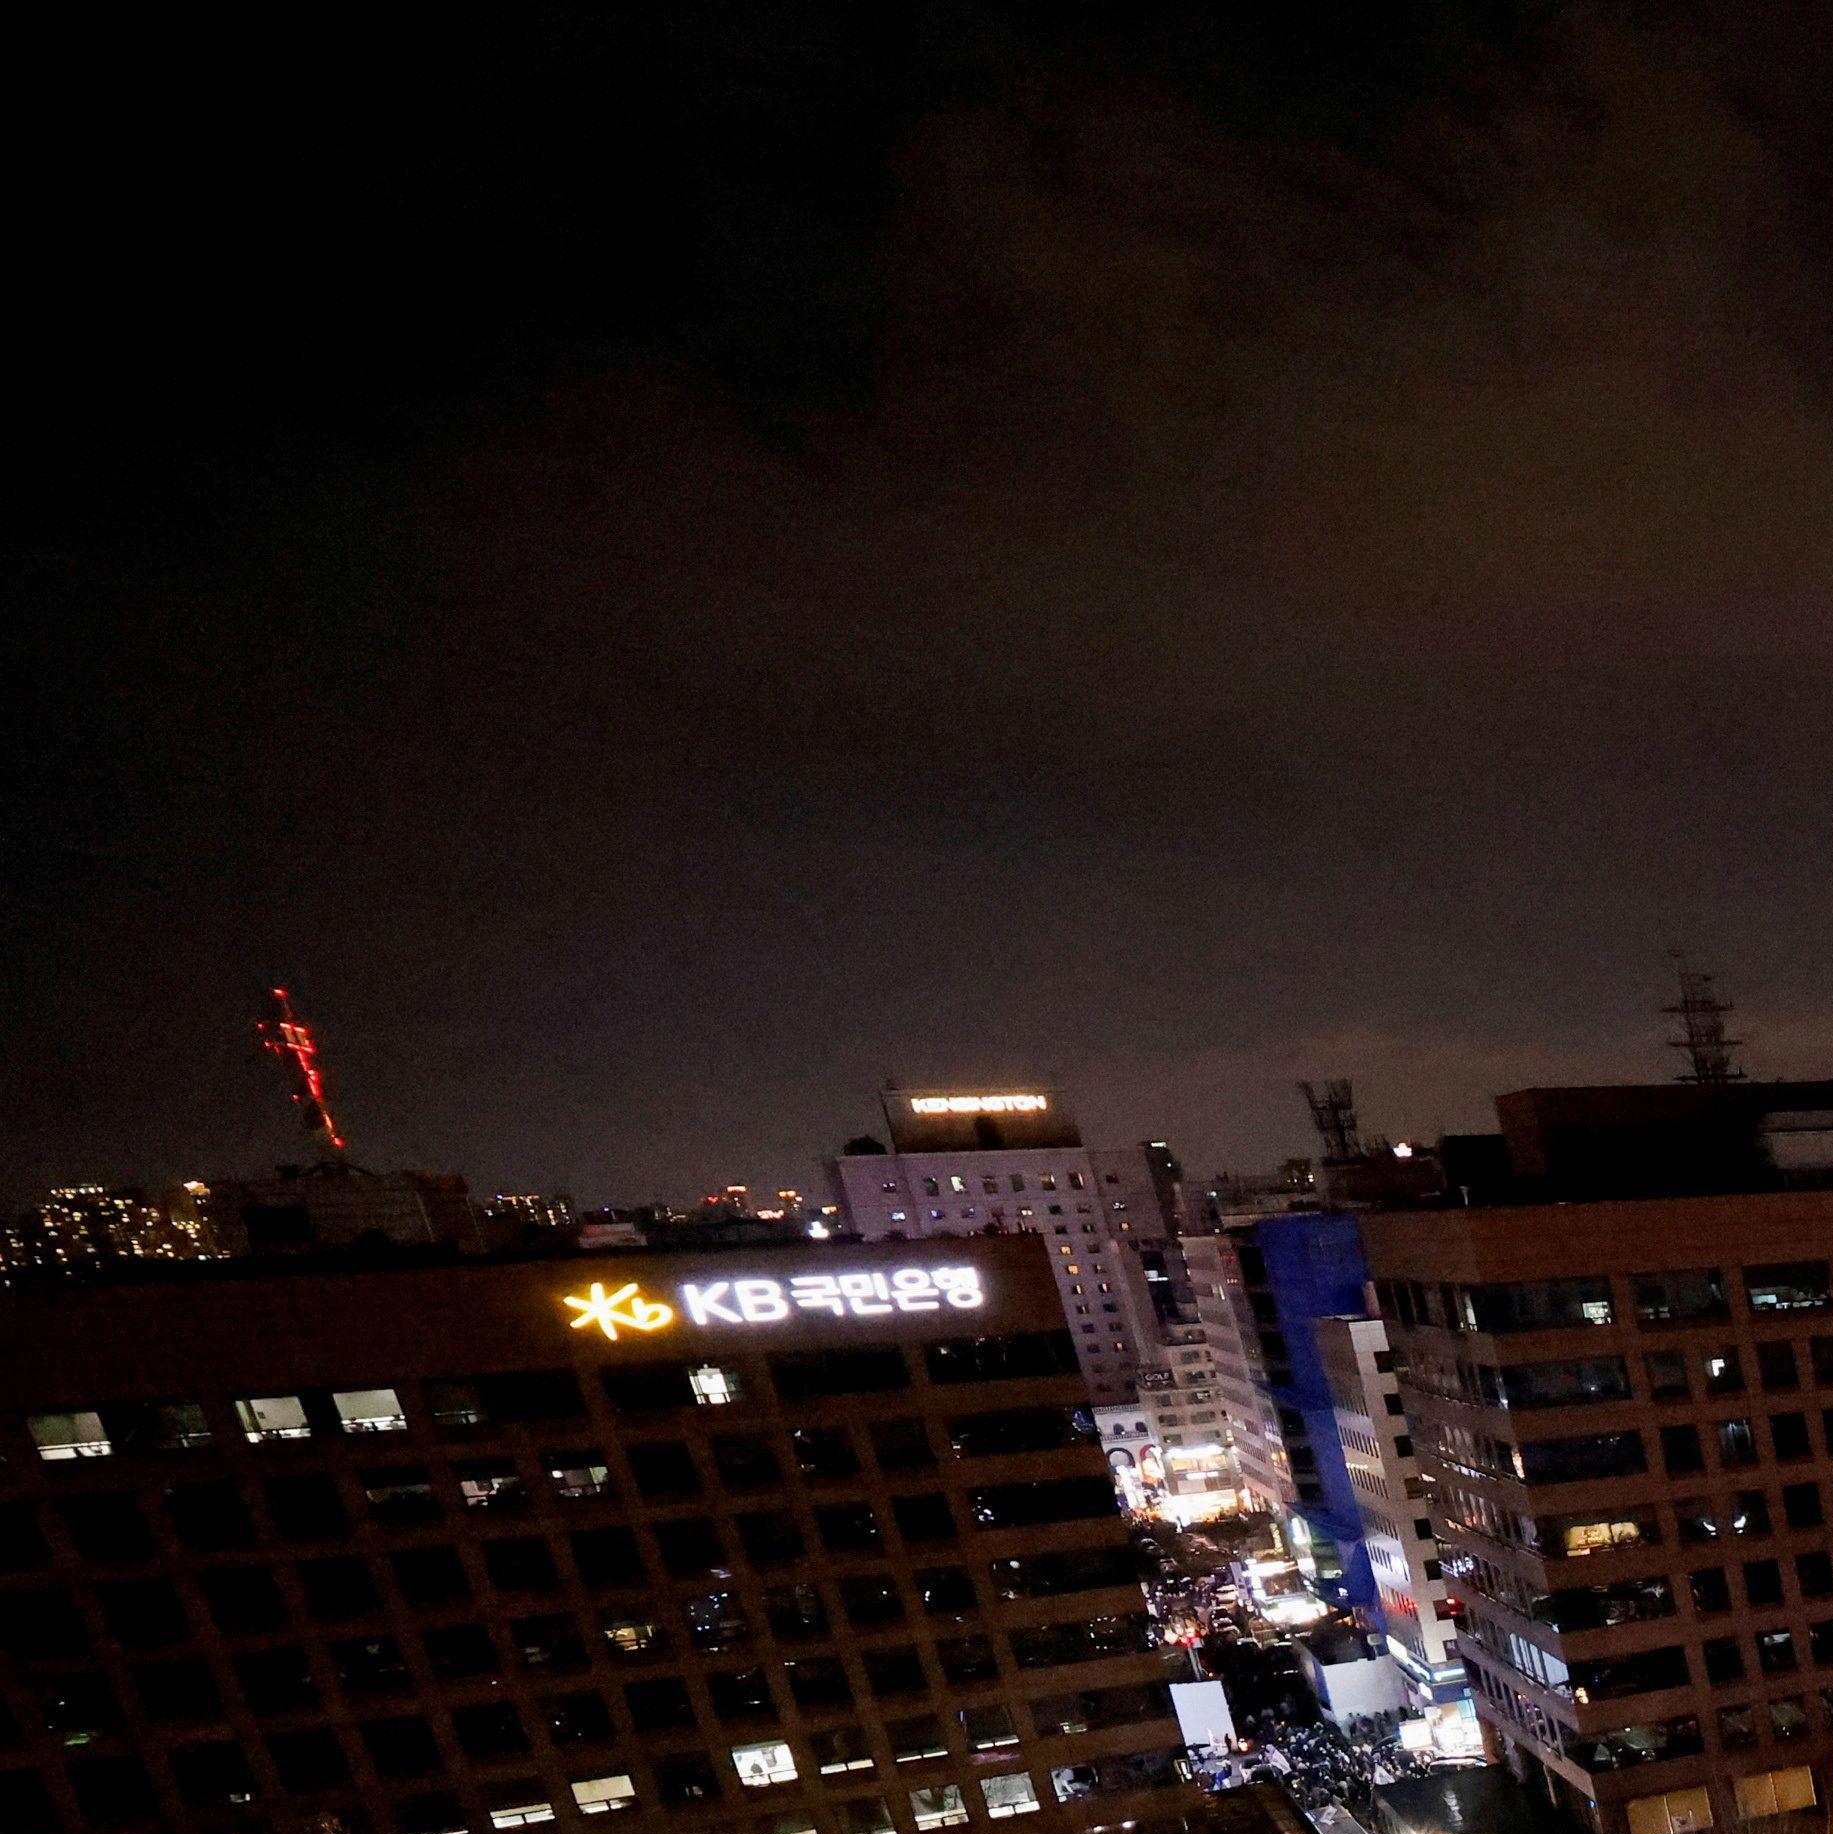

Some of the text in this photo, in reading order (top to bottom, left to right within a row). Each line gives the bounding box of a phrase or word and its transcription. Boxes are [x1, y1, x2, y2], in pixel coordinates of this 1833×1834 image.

[911, 1095, 1047, 1114] KENSINGTON
[684, 1266, 984, 1325] KB 국민은행
